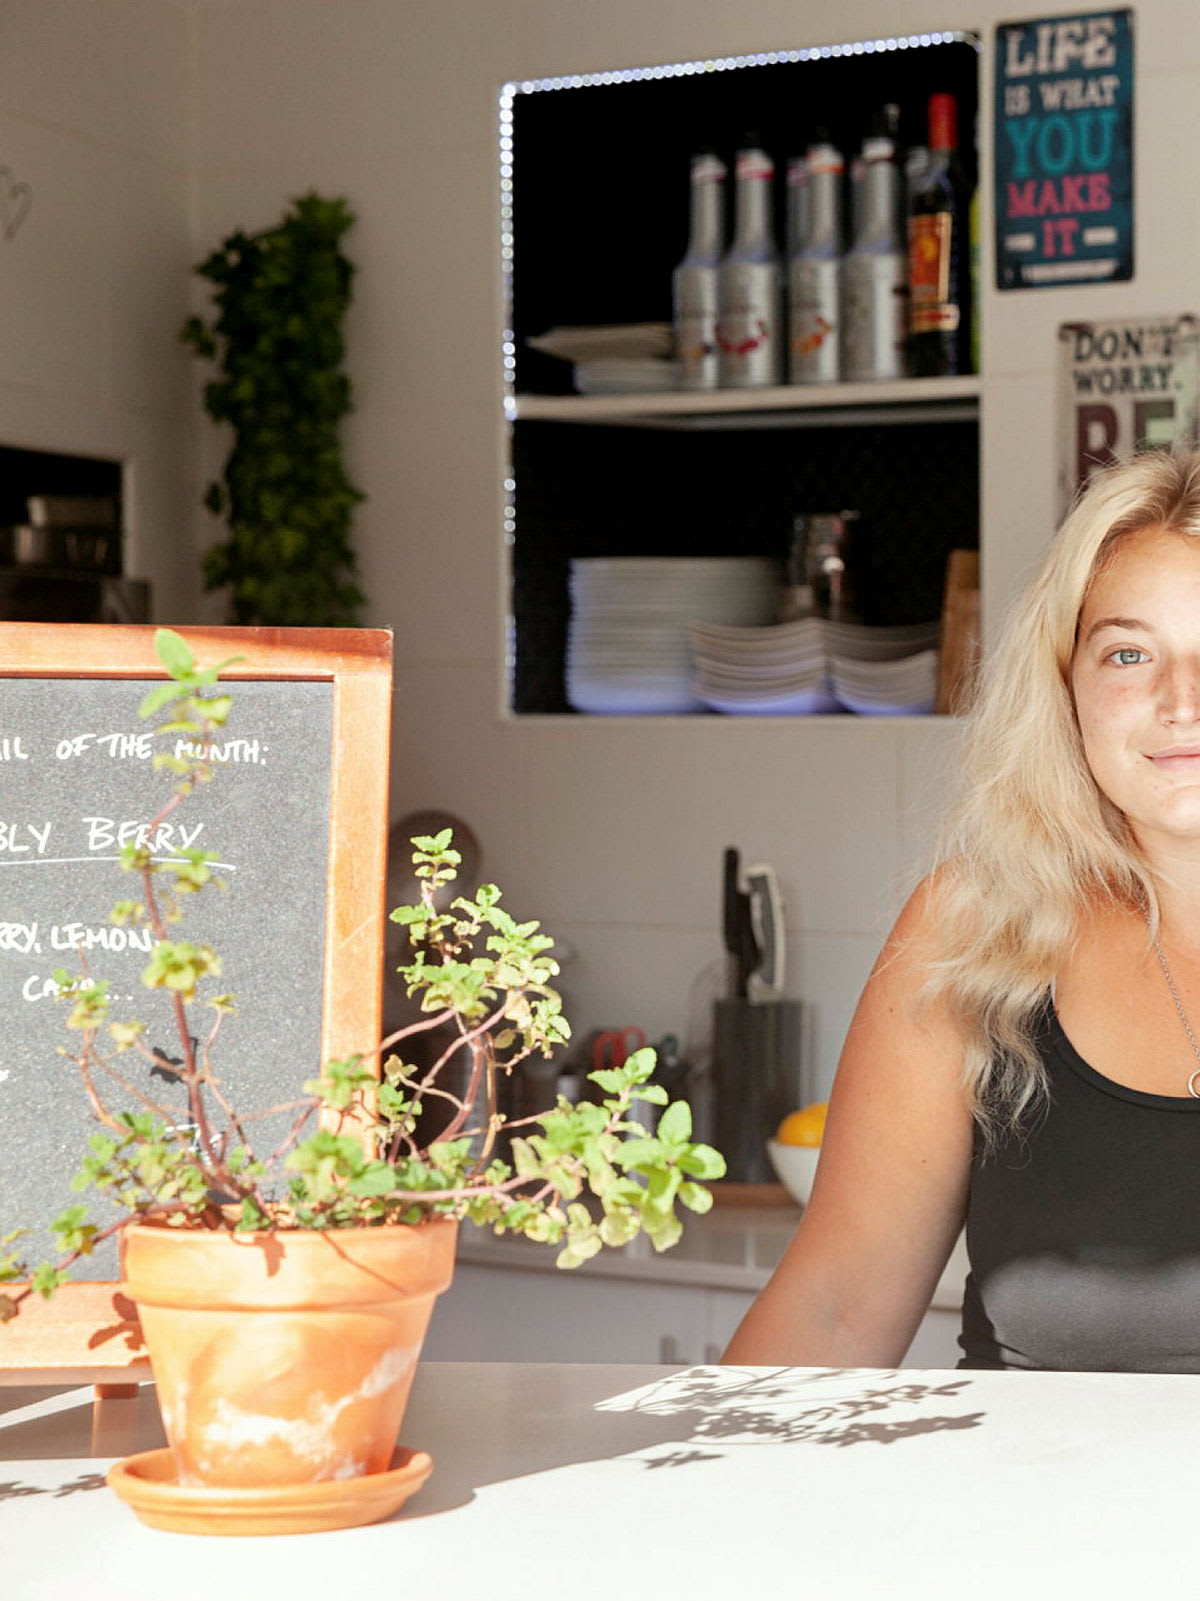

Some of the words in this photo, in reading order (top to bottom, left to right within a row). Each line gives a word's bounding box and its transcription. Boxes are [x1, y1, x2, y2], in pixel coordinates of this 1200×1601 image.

[1005, 17, 1117, 77] LIFE
[1005, 84, 1030, 116] IS
[1039, 75, 1120, 111] WHAT
[1005, 108, 1119, 177] YOU
[1007, 172, 1112, 218] MAKE
[1042, 218, 1080, 257] IT
[0, 736, 29, 761] IL
[56, 733, 97, 760] OF
[96, 733, 154, 759] THE
[82, 817, 204, 853] BERRY
